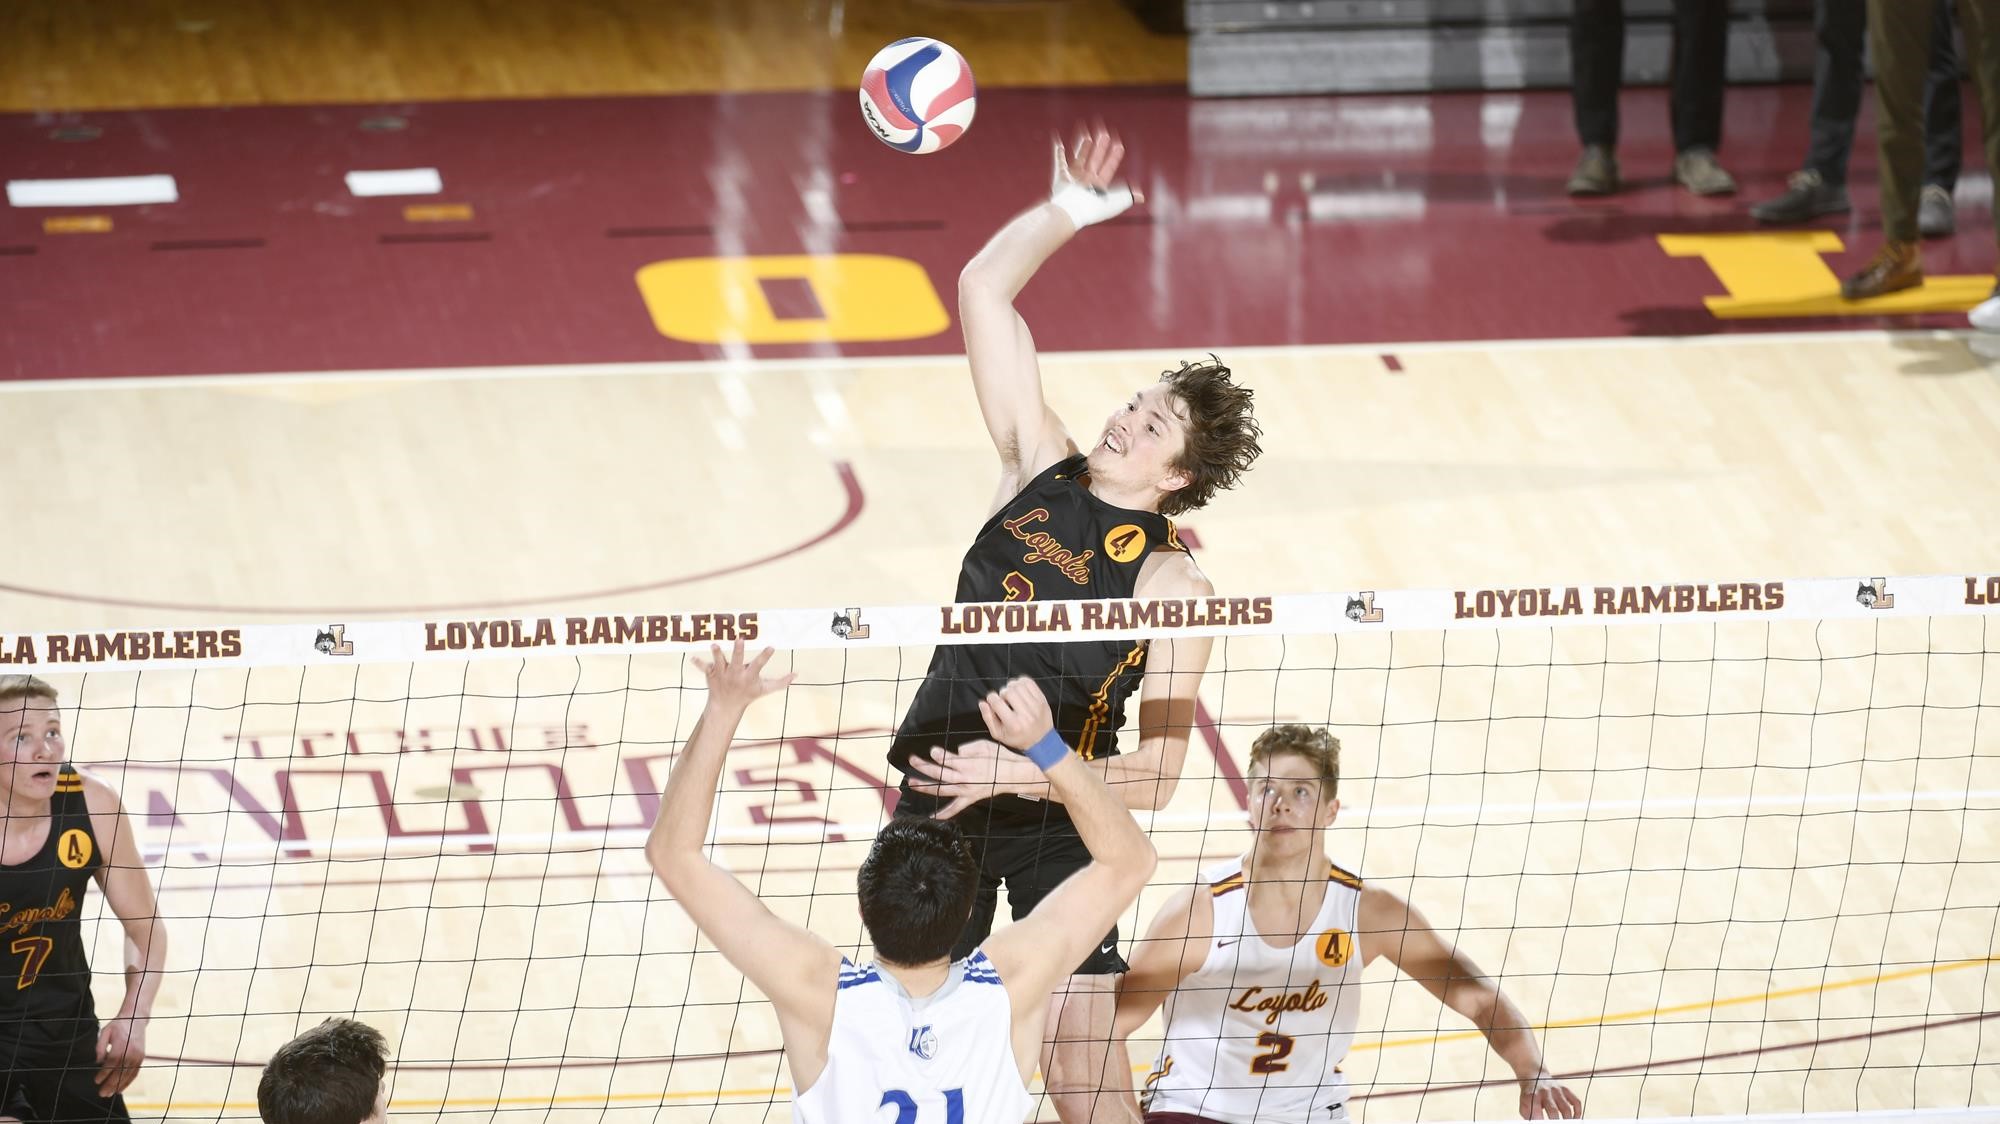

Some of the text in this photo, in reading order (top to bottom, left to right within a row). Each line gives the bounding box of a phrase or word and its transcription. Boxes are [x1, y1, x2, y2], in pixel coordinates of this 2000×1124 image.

[1003, 508, 1095, 585] Loyola
[940, 596, 1273, 634] LOYOLA RAMBLERS
[1454, 582, 1784, 619] LOYOLA RAMBLERS
[46, 629, 242, 663] RAMBLERS
[424, 612, 759, 652] LOYOLA RAMBLERS
[11, 936, 53, 990] 7
[1229, 979, 1329, 1025] Loyola
[1249, 1030, 1296, 1076] 2
